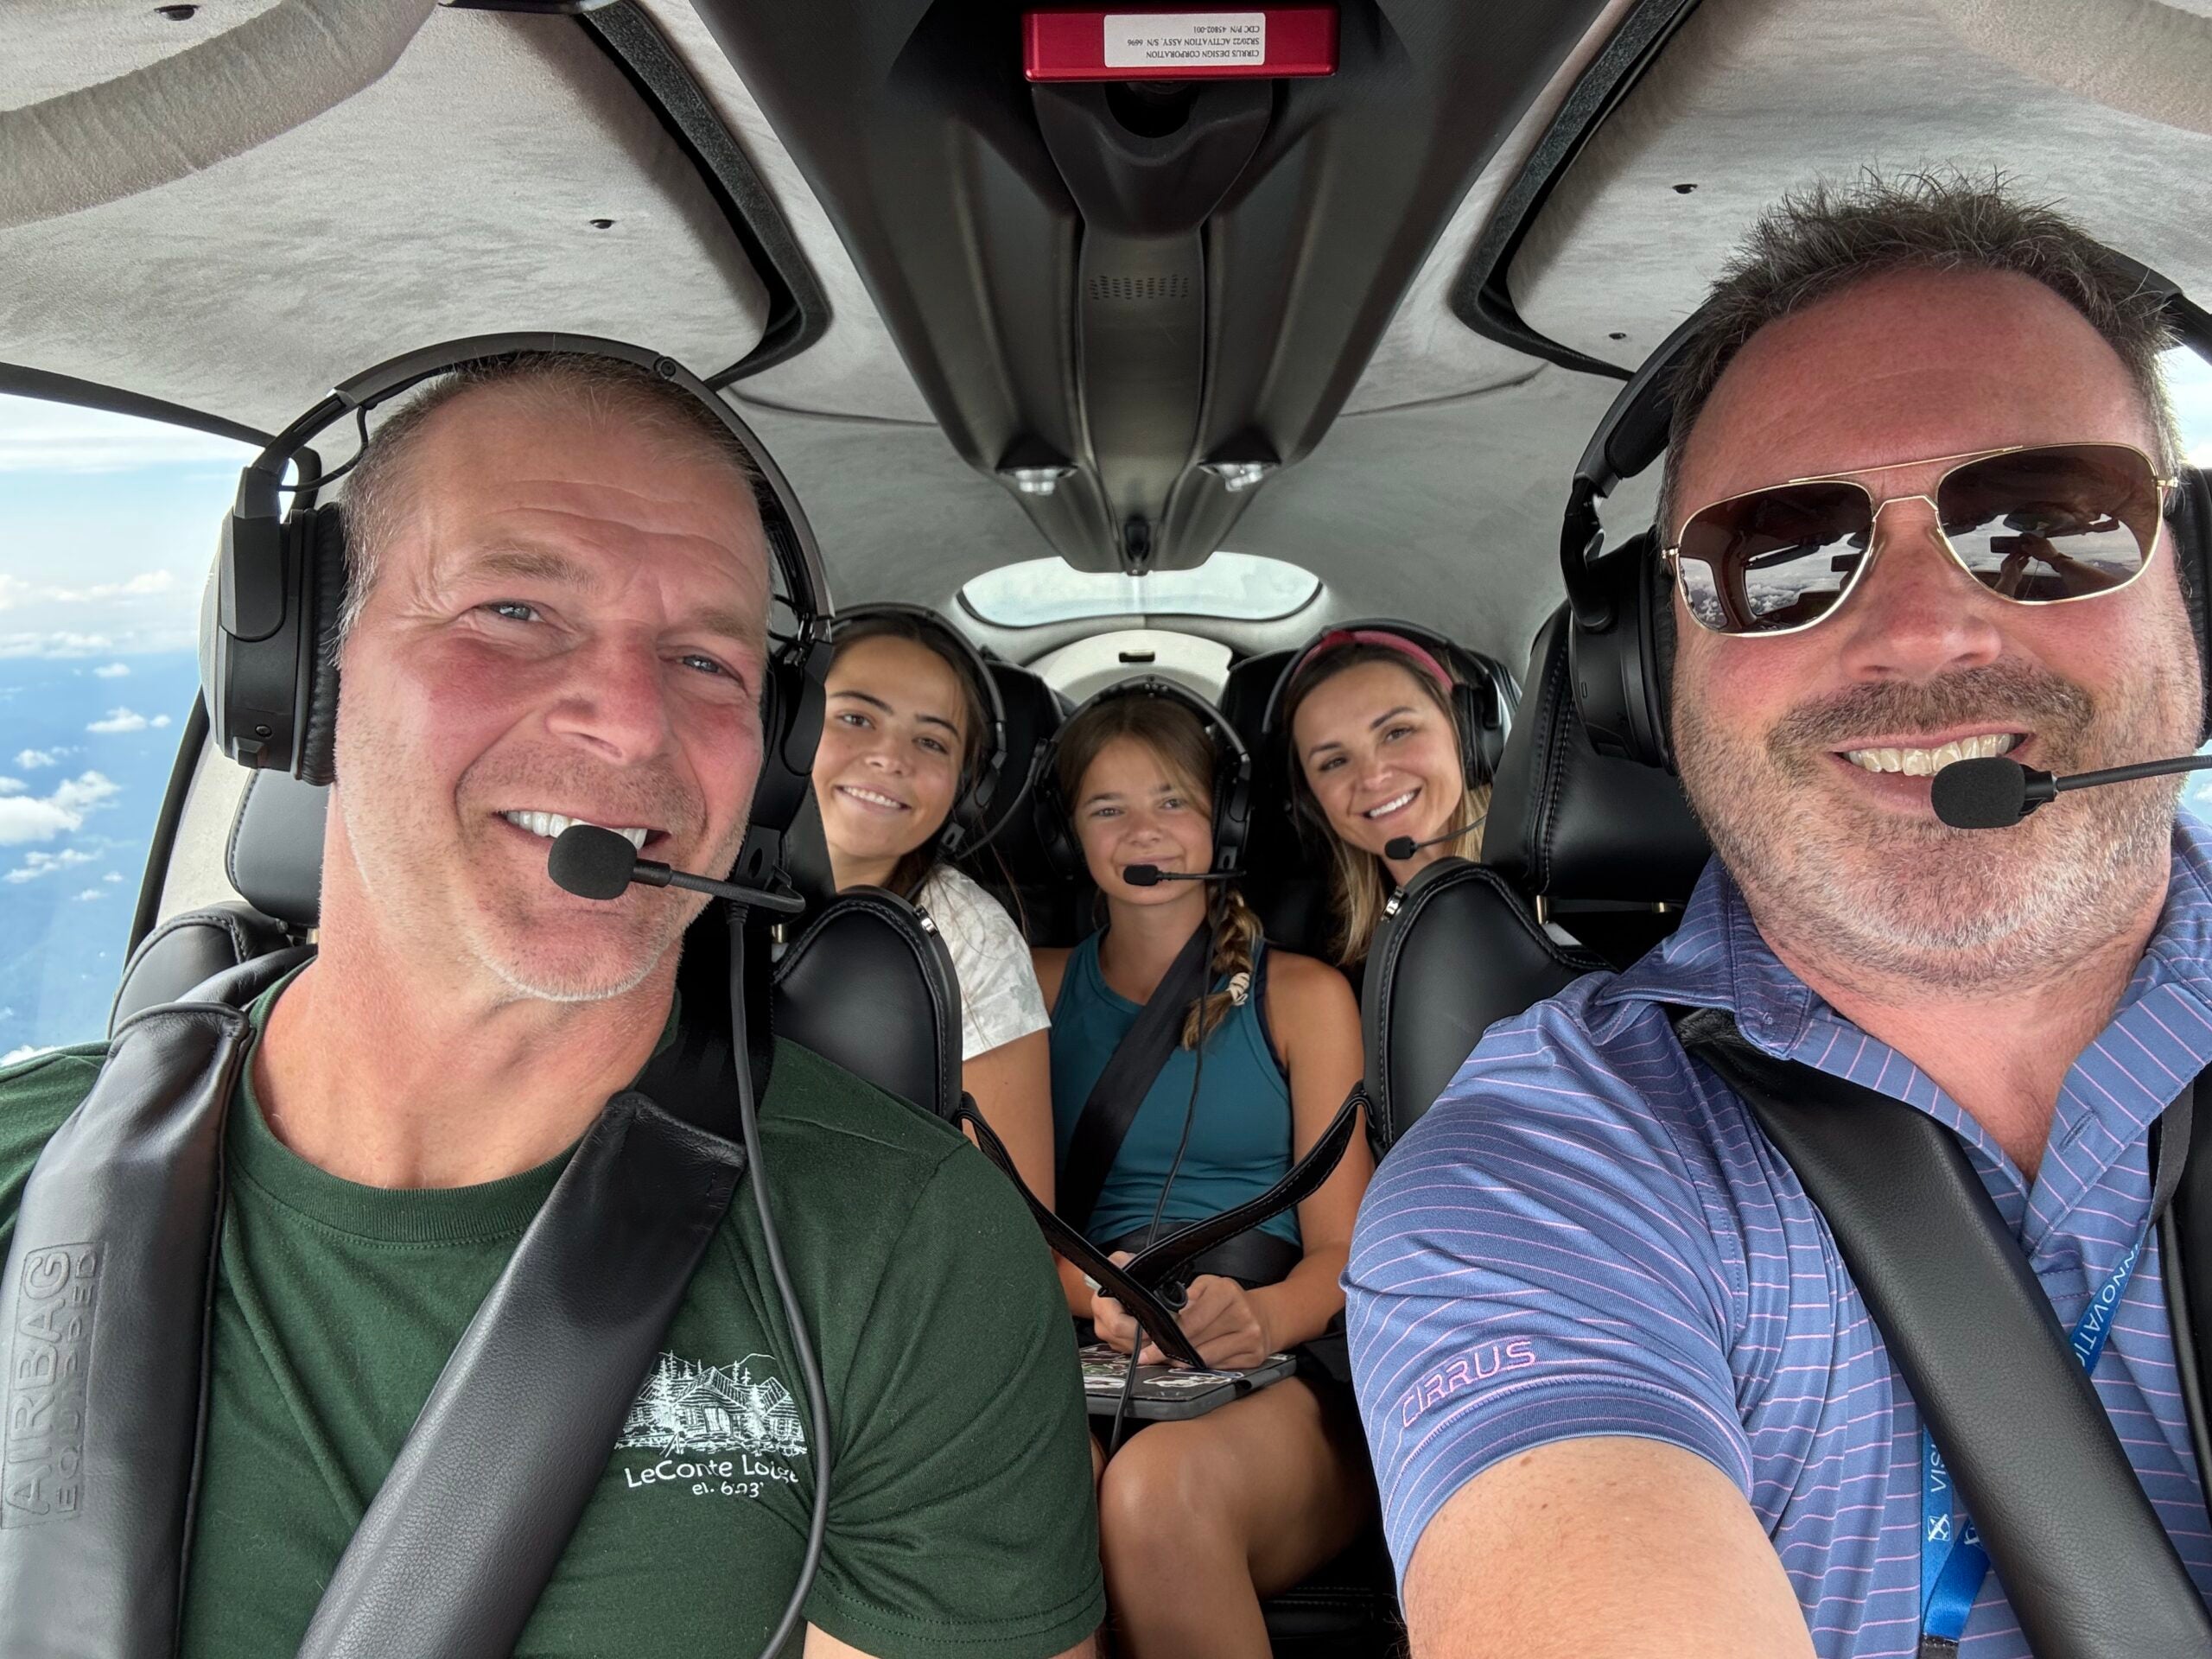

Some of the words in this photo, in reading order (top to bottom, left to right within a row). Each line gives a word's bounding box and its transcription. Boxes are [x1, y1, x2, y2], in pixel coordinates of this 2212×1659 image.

[1230, 25, 1243, 34] P/N
[1244, 25, 1260, 34] CDC
[1147, 38, 1160, 47] S/N
[1184, 38, 1231, 47] ACTIVATION
[1232, 37, 1260, 46] SR20/22
[1146, 50, 1200, 59] CORPORATION
[1202, 50, 1230, 59] DESIGN
[1231, 49, 1260, 58] CIRRUS
[5, 1251, 71, 1516] AIRBAG
[1402, 1340, 1536, 1428] CIRRUS
[624, 1459, 733, 1489] LeConte
[691, 1481, 715, 1496] el.
